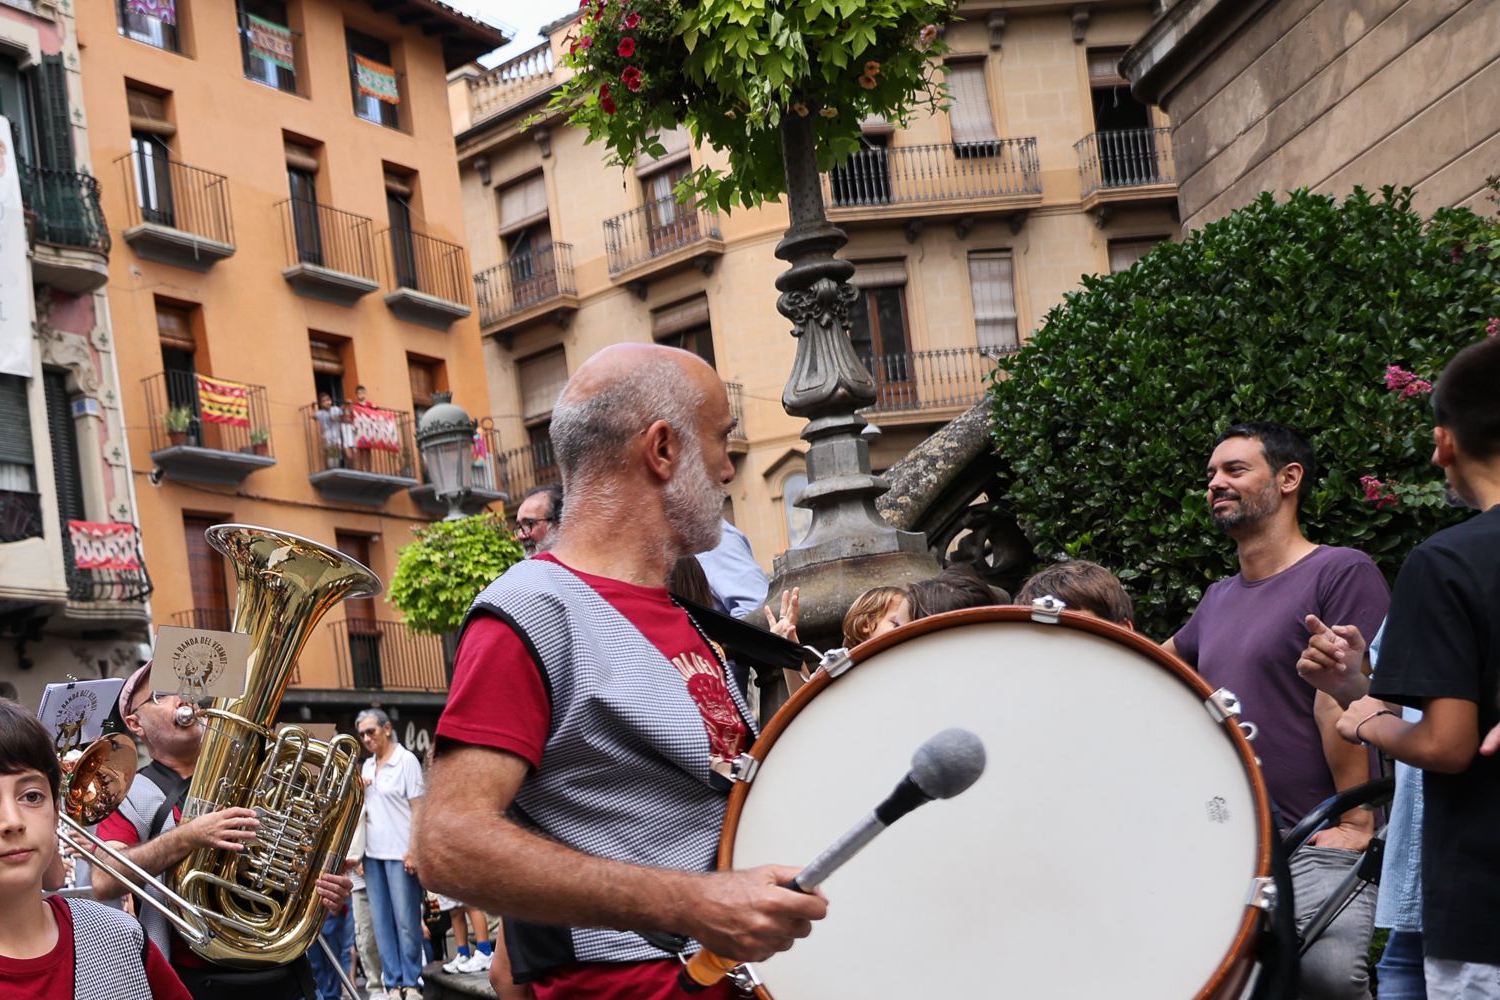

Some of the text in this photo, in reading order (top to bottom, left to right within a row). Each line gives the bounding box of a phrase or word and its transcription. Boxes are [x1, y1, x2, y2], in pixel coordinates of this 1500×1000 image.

[171, 636, 228, 665] LA BANDA DEL VERMUT
